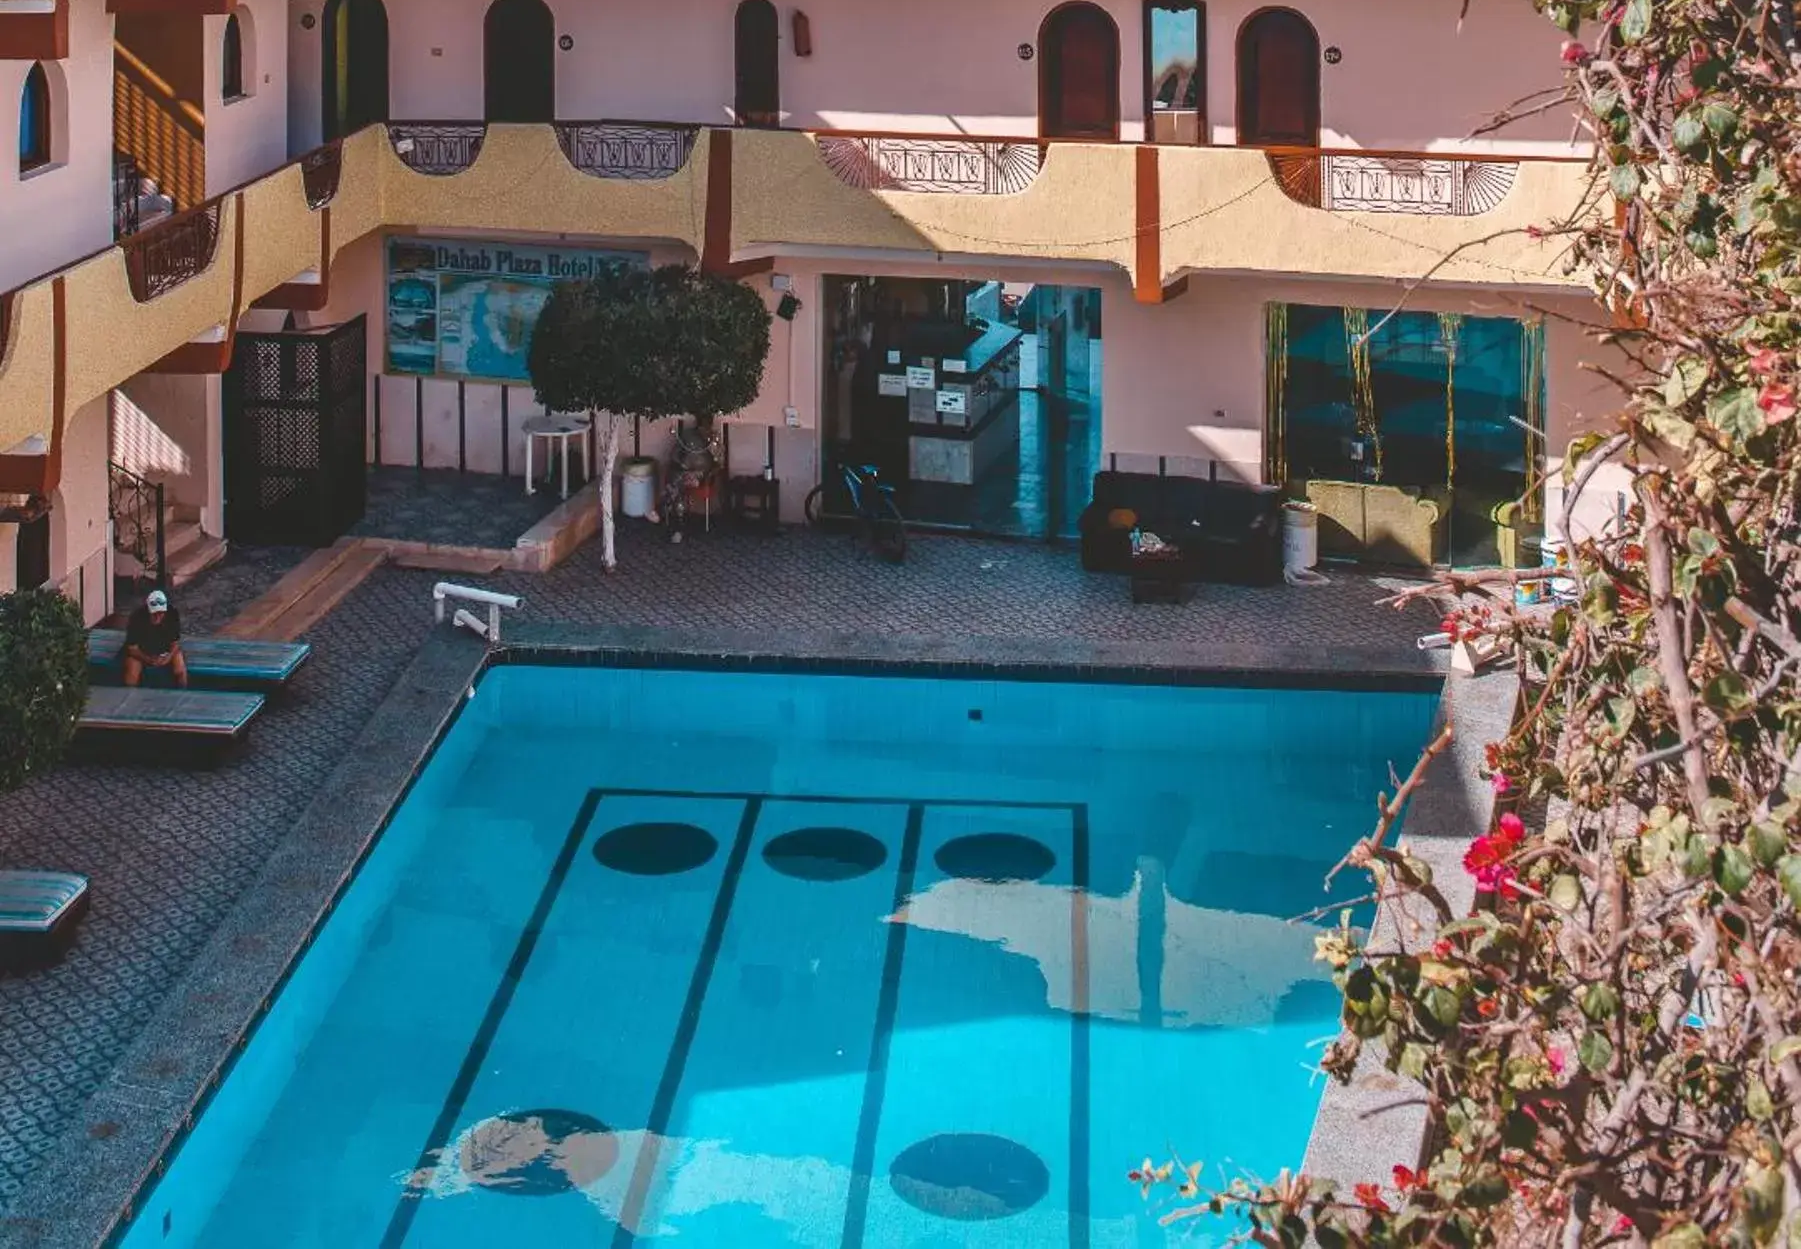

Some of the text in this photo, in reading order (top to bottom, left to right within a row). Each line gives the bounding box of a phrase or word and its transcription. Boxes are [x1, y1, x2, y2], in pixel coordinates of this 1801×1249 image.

[437, 245, 592, 278] Dahab Plaza Hotel
